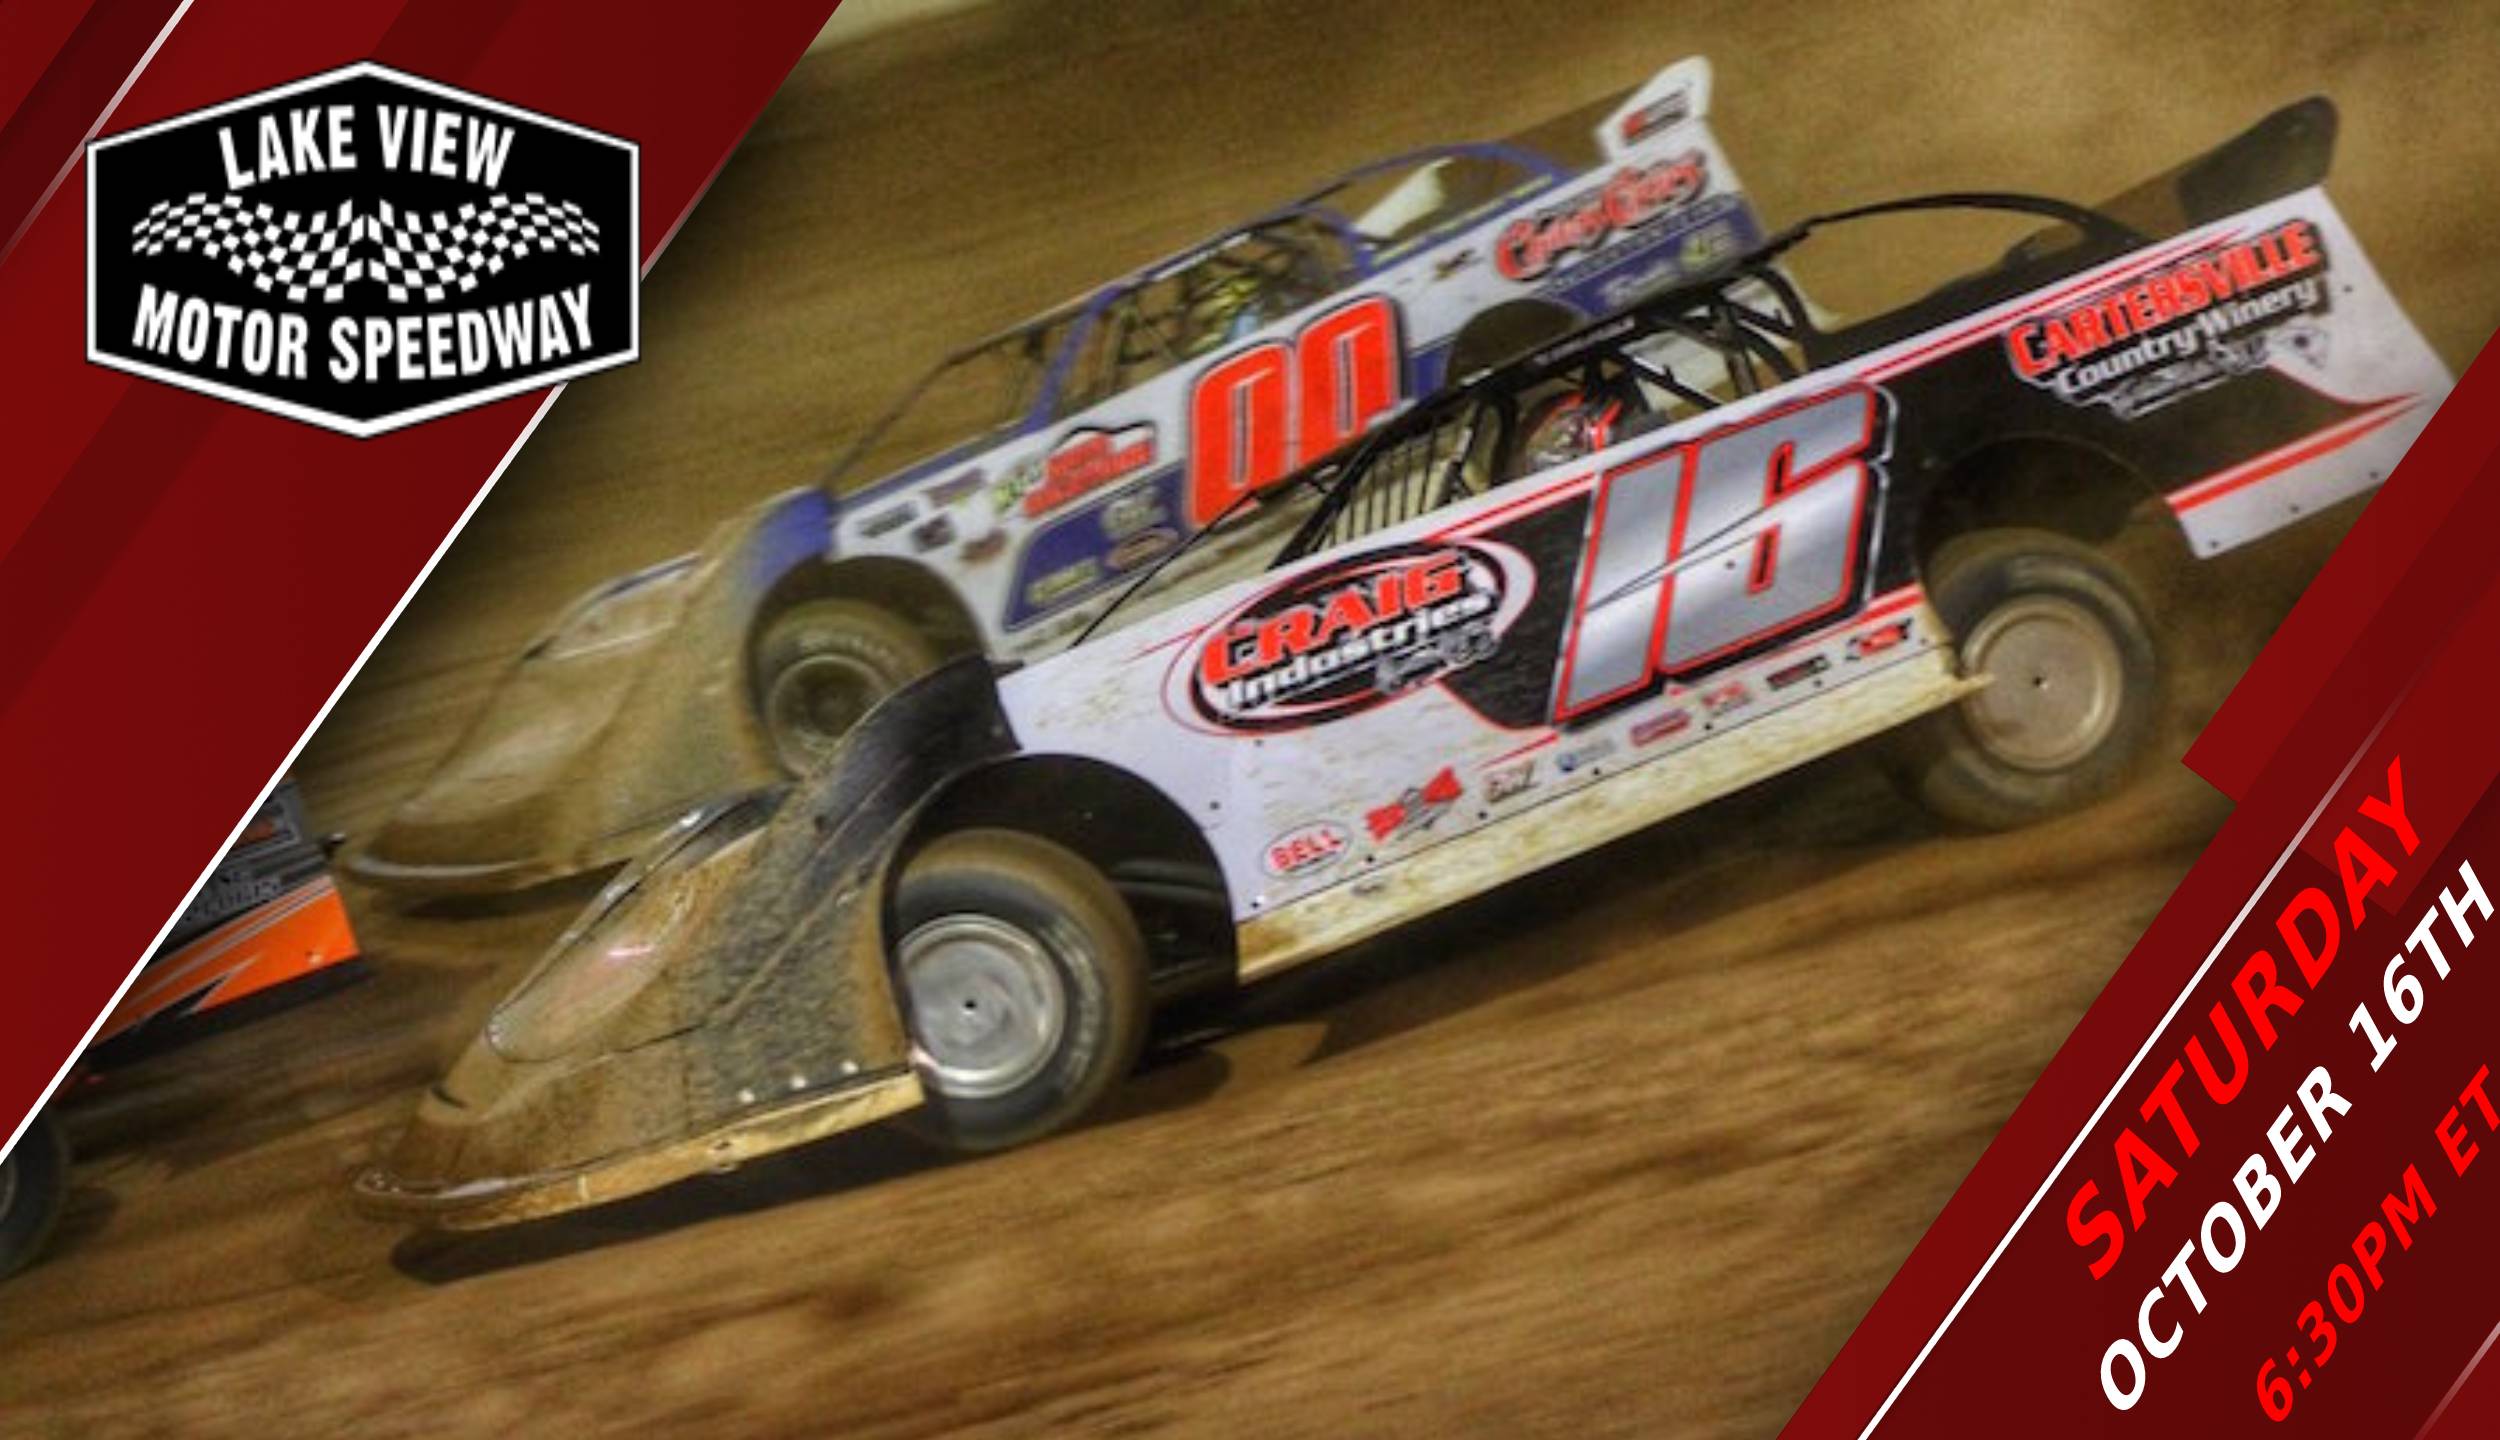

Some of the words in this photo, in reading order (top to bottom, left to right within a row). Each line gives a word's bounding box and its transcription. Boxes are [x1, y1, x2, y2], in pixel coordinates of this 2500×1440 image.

[2009, 219, 2320, 377] CARTERSVILLE
[2055, 324, 2199, 394] Country
[2199, 274, 2320, 338] Winery
[1553, 382, 1892, 724] 16
[1202, 551, 1463, 684] CRAIG
[1226, 592, 1494, 710] Industries
[1269, 829, 1343, 872] BELL
